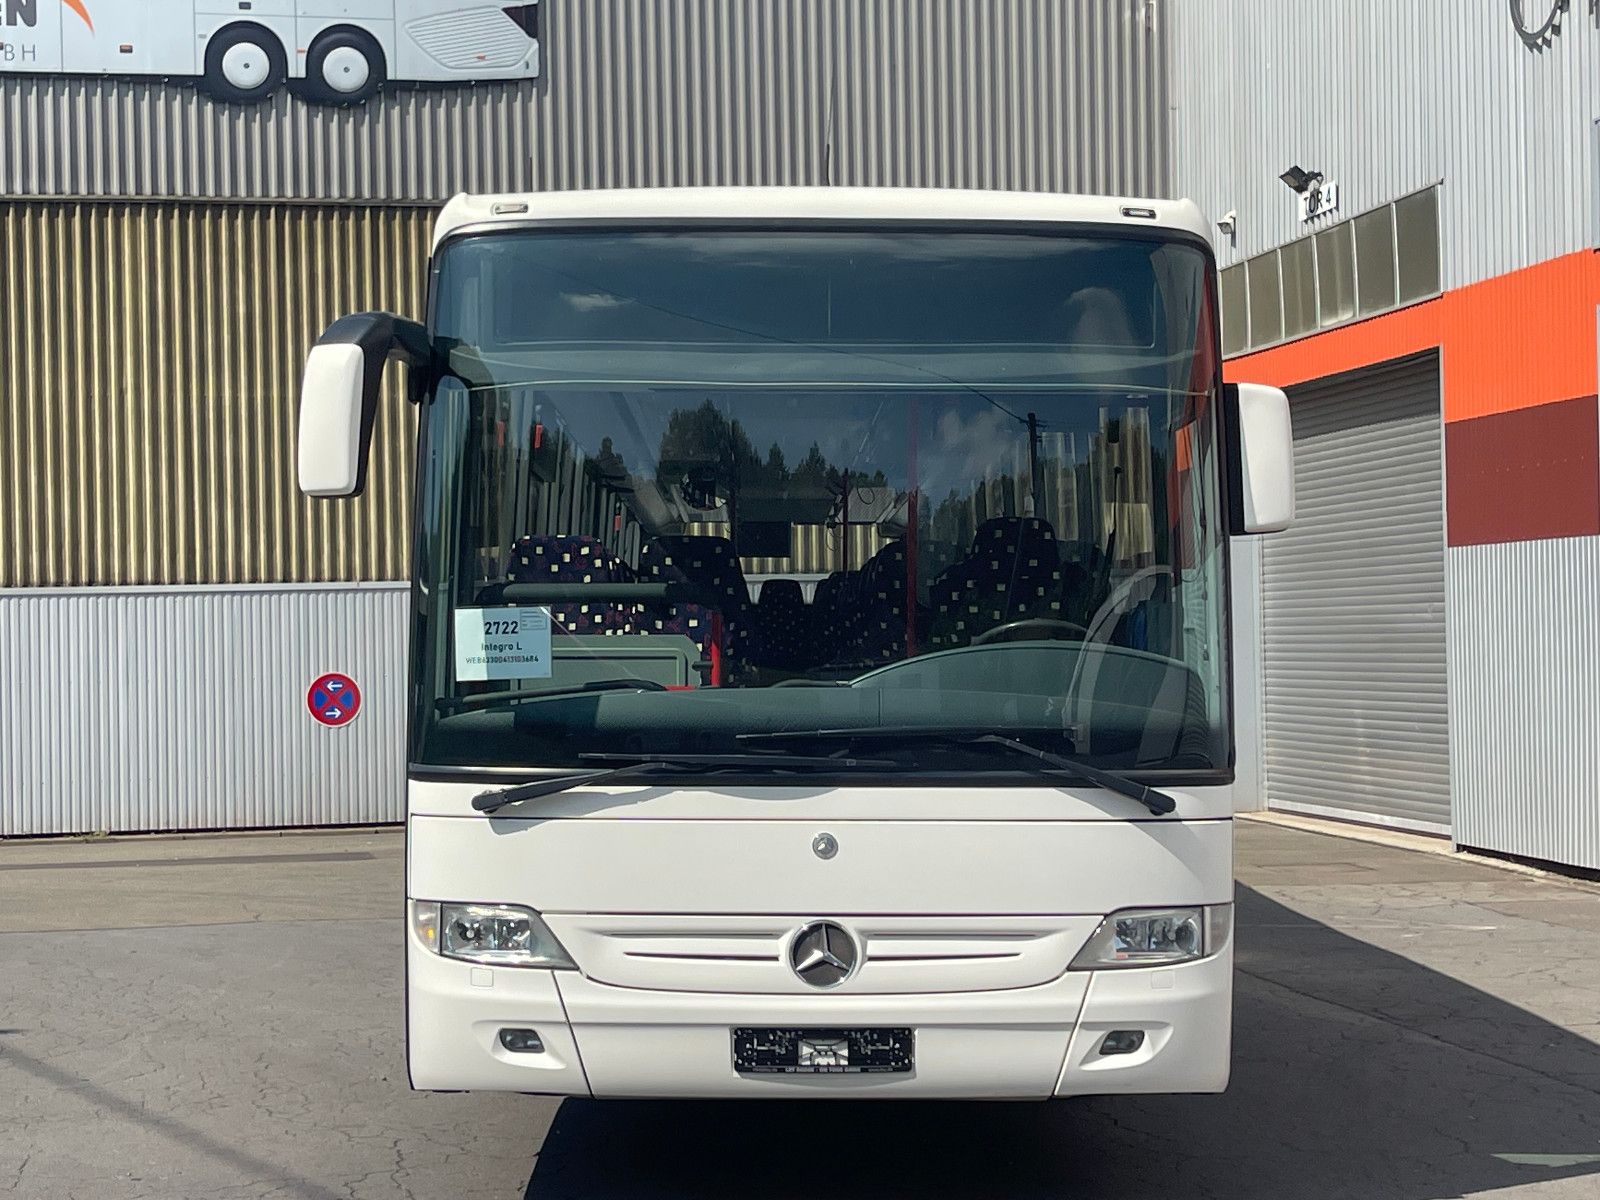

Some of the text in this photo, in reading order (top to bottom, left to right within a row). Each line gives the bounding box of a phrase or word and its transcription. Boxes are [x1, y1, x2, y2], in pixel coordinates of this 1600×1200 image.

[1303, 186, 1332, 215] TOR 4
[484, 621, 519, 635] 2722
[481, 642, 522, 652] Integro L
